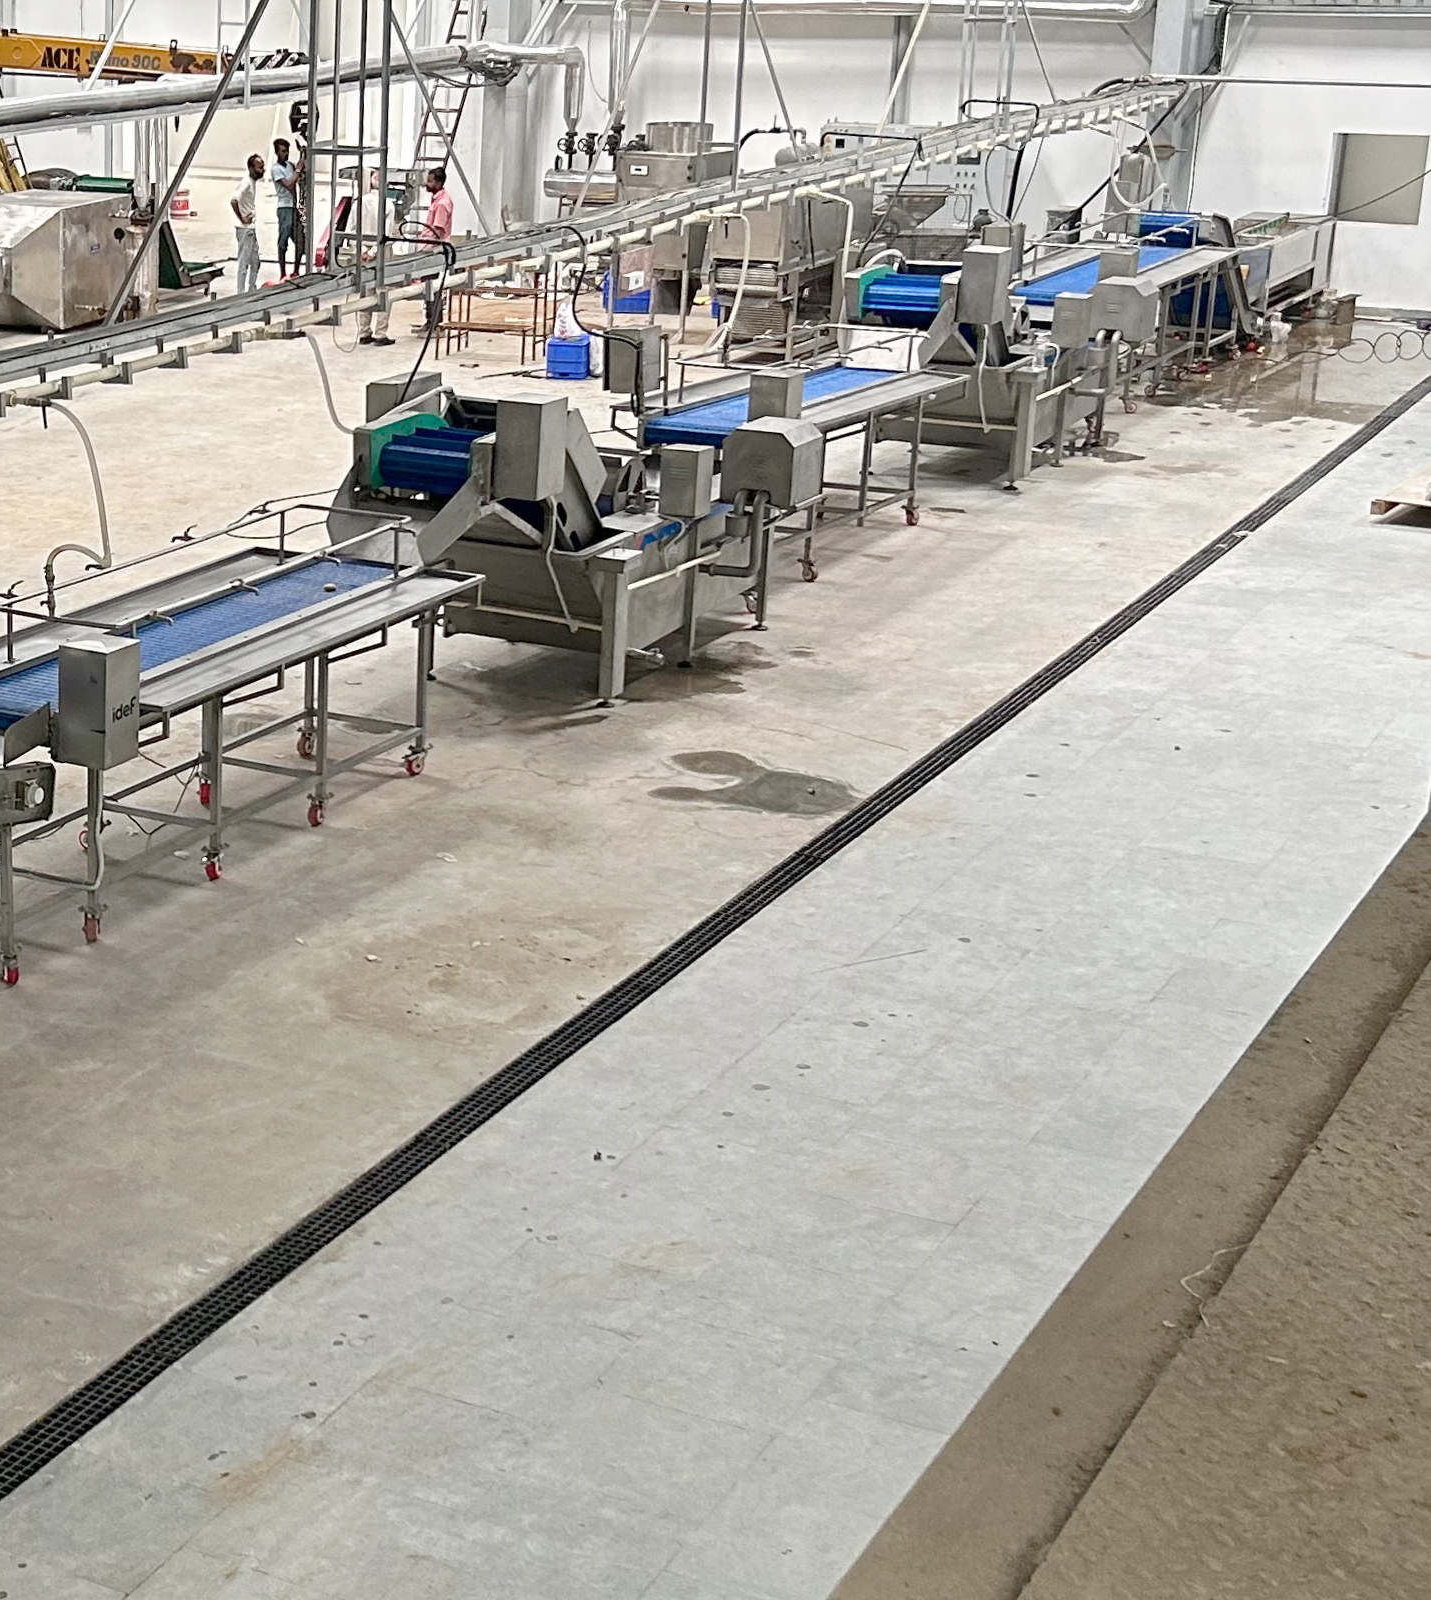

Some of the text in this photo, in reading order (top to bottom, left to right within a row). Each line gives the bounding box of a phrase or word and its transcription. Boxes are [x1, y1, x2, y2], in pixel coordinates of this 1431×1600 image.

[40, 46, 81, 71] ACE
[90, 50, 129, 68] Rino
[112, 696, 136, 723] idef
